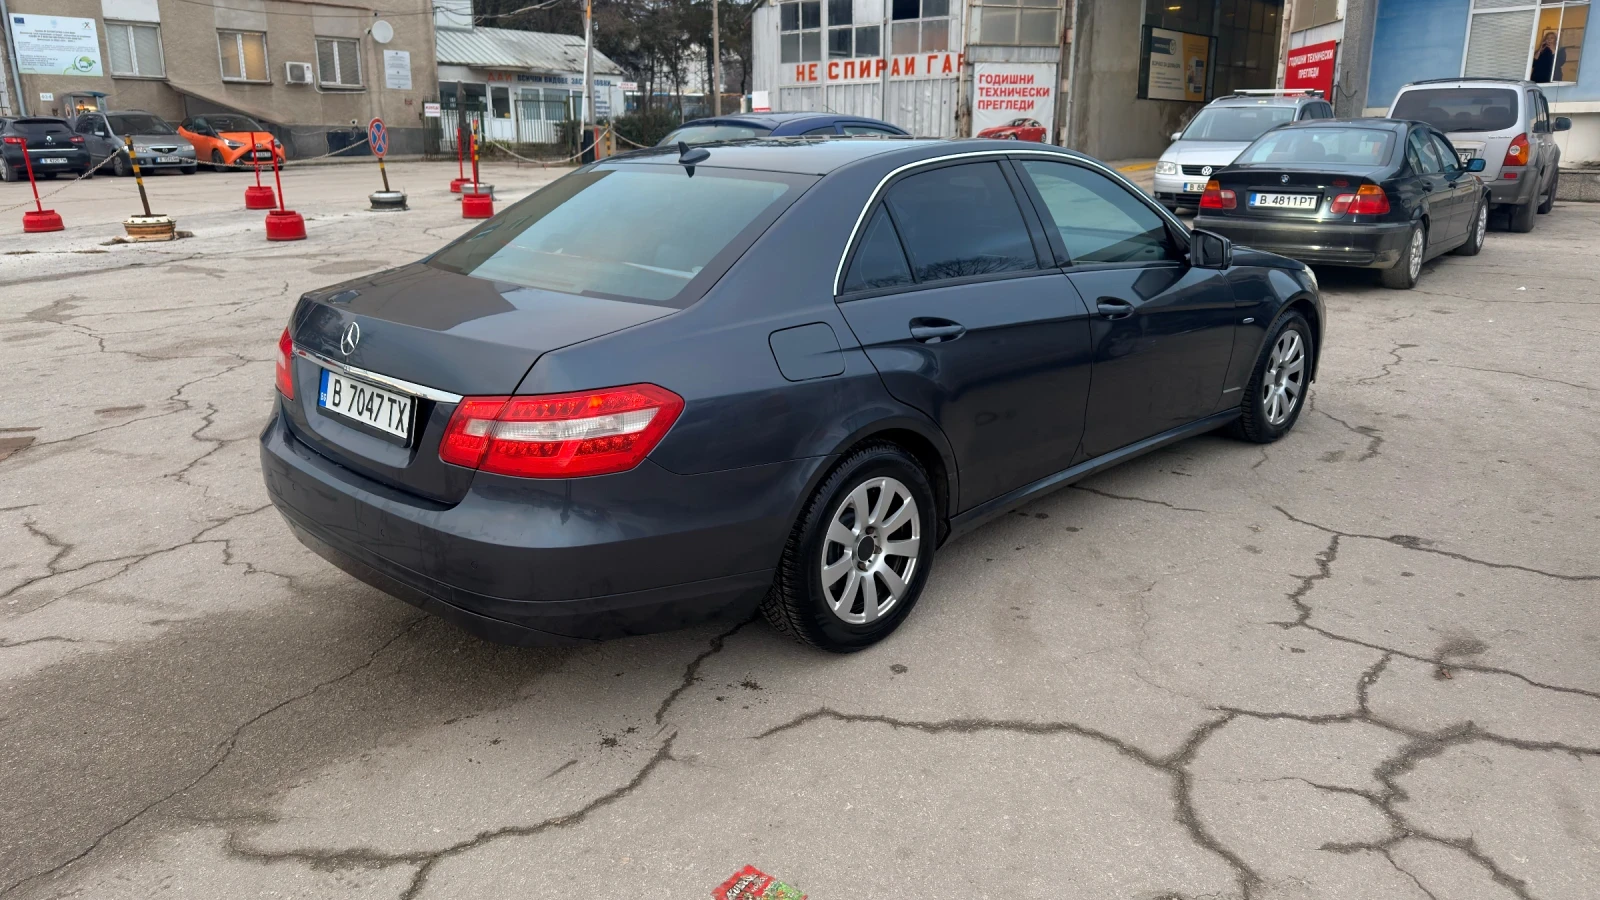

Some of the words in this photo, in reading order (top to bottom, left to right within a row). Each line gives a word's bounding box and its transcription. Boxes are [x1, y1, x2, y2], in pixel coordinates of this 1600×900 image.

[1289, 55, 1307, 67] ГОДИШНИ
[1307, 49, 1334, 63] ТЕХНИЧЕСКИ
[796, 64, 818, 82] НЕ
[1298, 67, 1319, 79] ПРЕГЛЕДИ
[517, 74, 542, 83] ВСИЧКИ
[544, 75, 568, 85] ВИДОВЕ
[979, 74, 1034, 86] ГОДИШНИ
[978, 87, 1050, 98] ТЕХНИЧЕСКИ
[978, 100, 1034, 111] ПРЕГЛЕДИ
[1260, 195, 1267, 204] B
[1272, 195, 1297, 206] 4811
[1300, 197, 1315, 206] PT
[332, 378, 342, 407] B
[348, 384, 384, 422] 7047
[387, 396, 407, 433] TX
